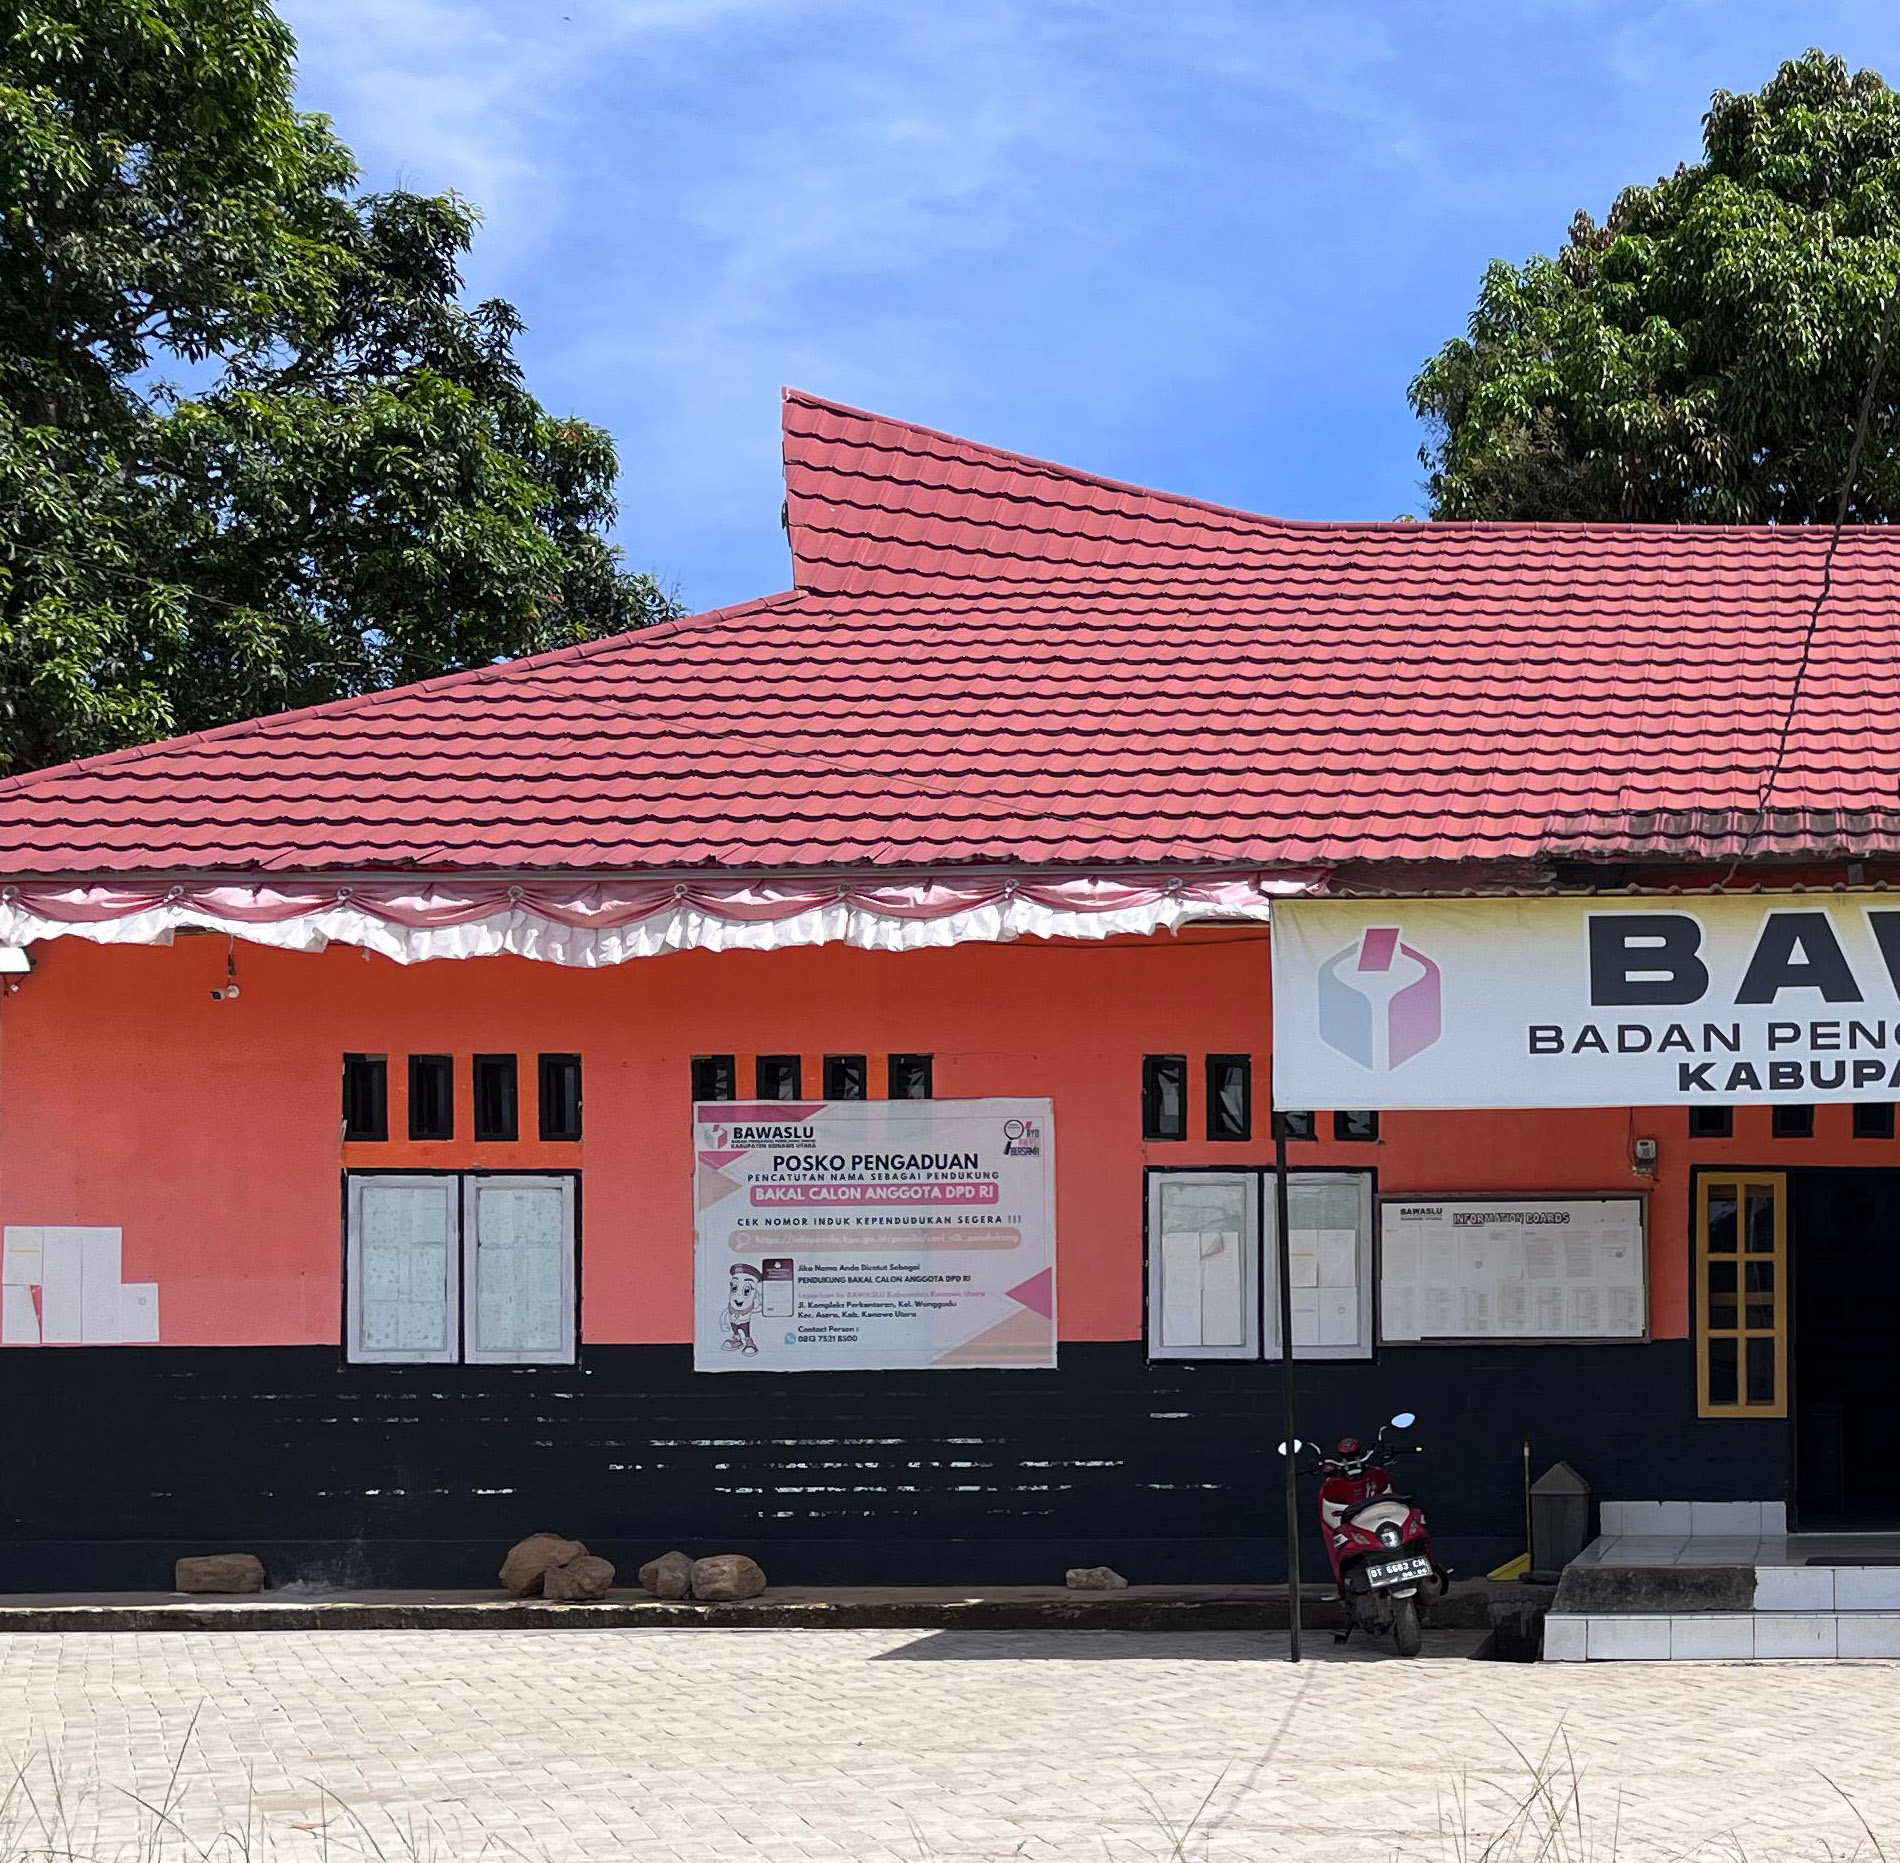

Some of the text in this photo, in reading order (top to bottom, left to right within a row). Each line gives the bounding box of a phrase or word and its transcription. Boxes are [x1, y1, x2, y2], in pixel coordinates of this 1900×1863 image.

[1529, 1022, 1740, 1054] BADAN
[733, 1126, 813, 1139] BAWASLU
[773, 1153, 978, 1172] POSKO PENGADUAN
[747, 1171, 999, 1182] PENCATUTAN NAMA SEBAGAI PENDUKUNG
[755, 1185, 993, 1200] BAKAL CALON ANGGOTA DPD RI
[737, 1218, 758, 1226] CEK
[764, 1217, 808, 1226] NOMOR
[813, 1217, 850, 1226] INDUK
[856, 1216, 951, 1225] KEPENDUDUKAN
[957, 1215, 1001, 1224] SEGERA
